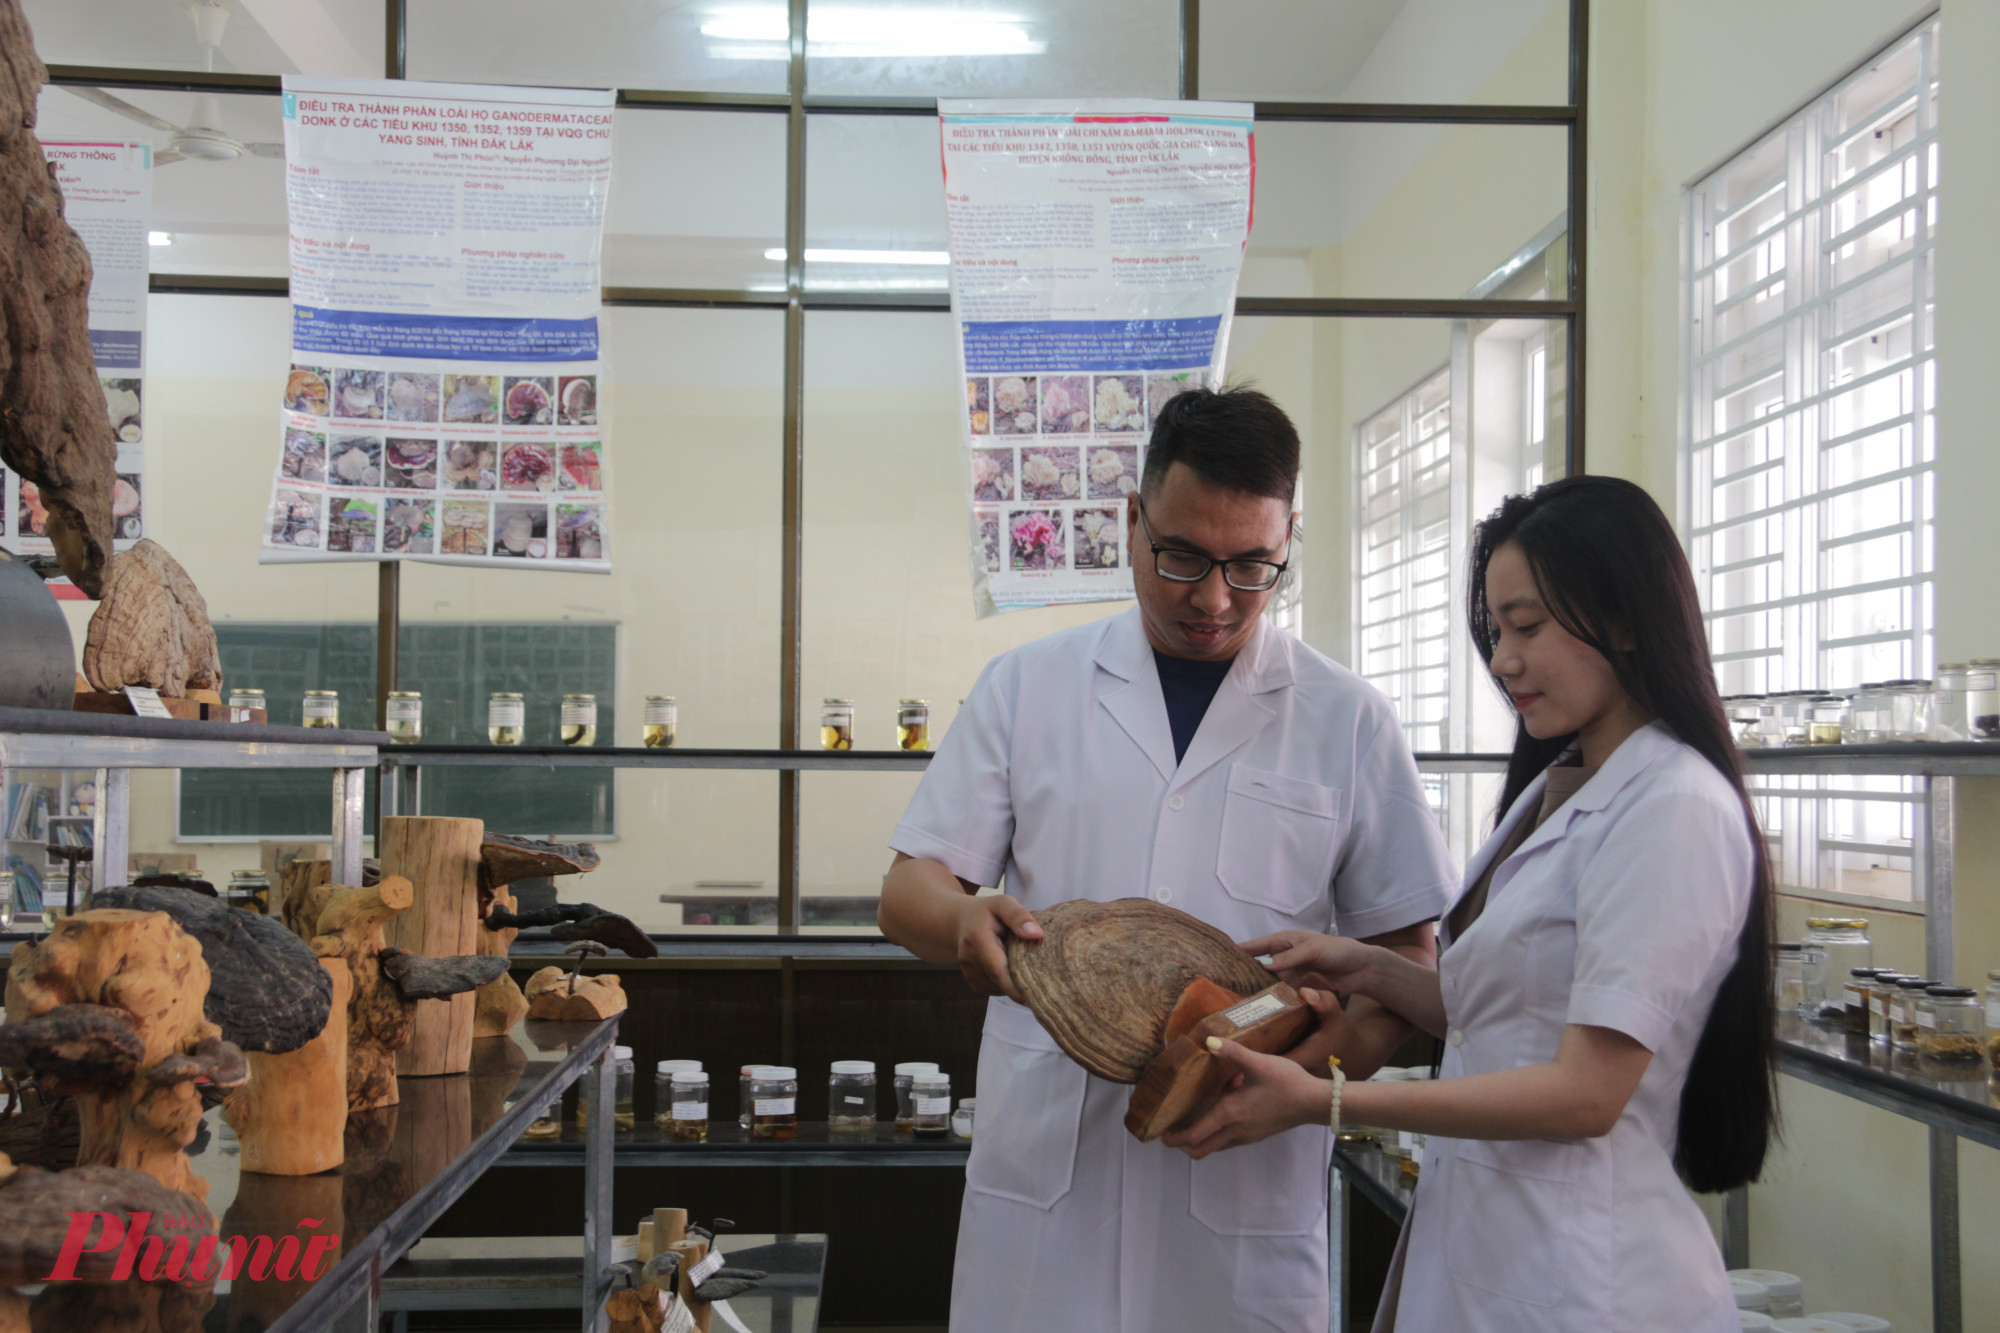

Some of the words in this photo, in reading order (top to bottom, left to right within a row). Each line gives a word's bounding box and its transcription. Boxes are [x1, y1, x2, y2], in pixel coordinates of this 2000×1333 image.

[331, 102, 355, 113] TRA
[359, 102, 399, 115] THÀNH
[440, 107, 467, 119] LOÀI
[471, 110, 489, 121] HỌ
[301, 116, 336, 127] DONK
[353, 117, 378, 129] CÁC
[412, 120, 437, 132] KHU
[442, 122, 470, 134] 1350,
[507, 125, 532, 136] 1359
[536, 127, 554, 139] TẠI
[557, 128, 583, 139] VQG
[976, 128, 995, 137] TRA
[1082, 128, 1099, 137] CHI
[379, 134, 413, 146] YANG
[416, 136, 447, 148] SINH,
[963, 142, 980, 152] CÁC
[1005, 143, 1025, 151] KHU
[1082, 143, 1103, 151] 1351
[1163, 141, 1178, 149] GIA
[80, 150, 116, 160] THÔNG
